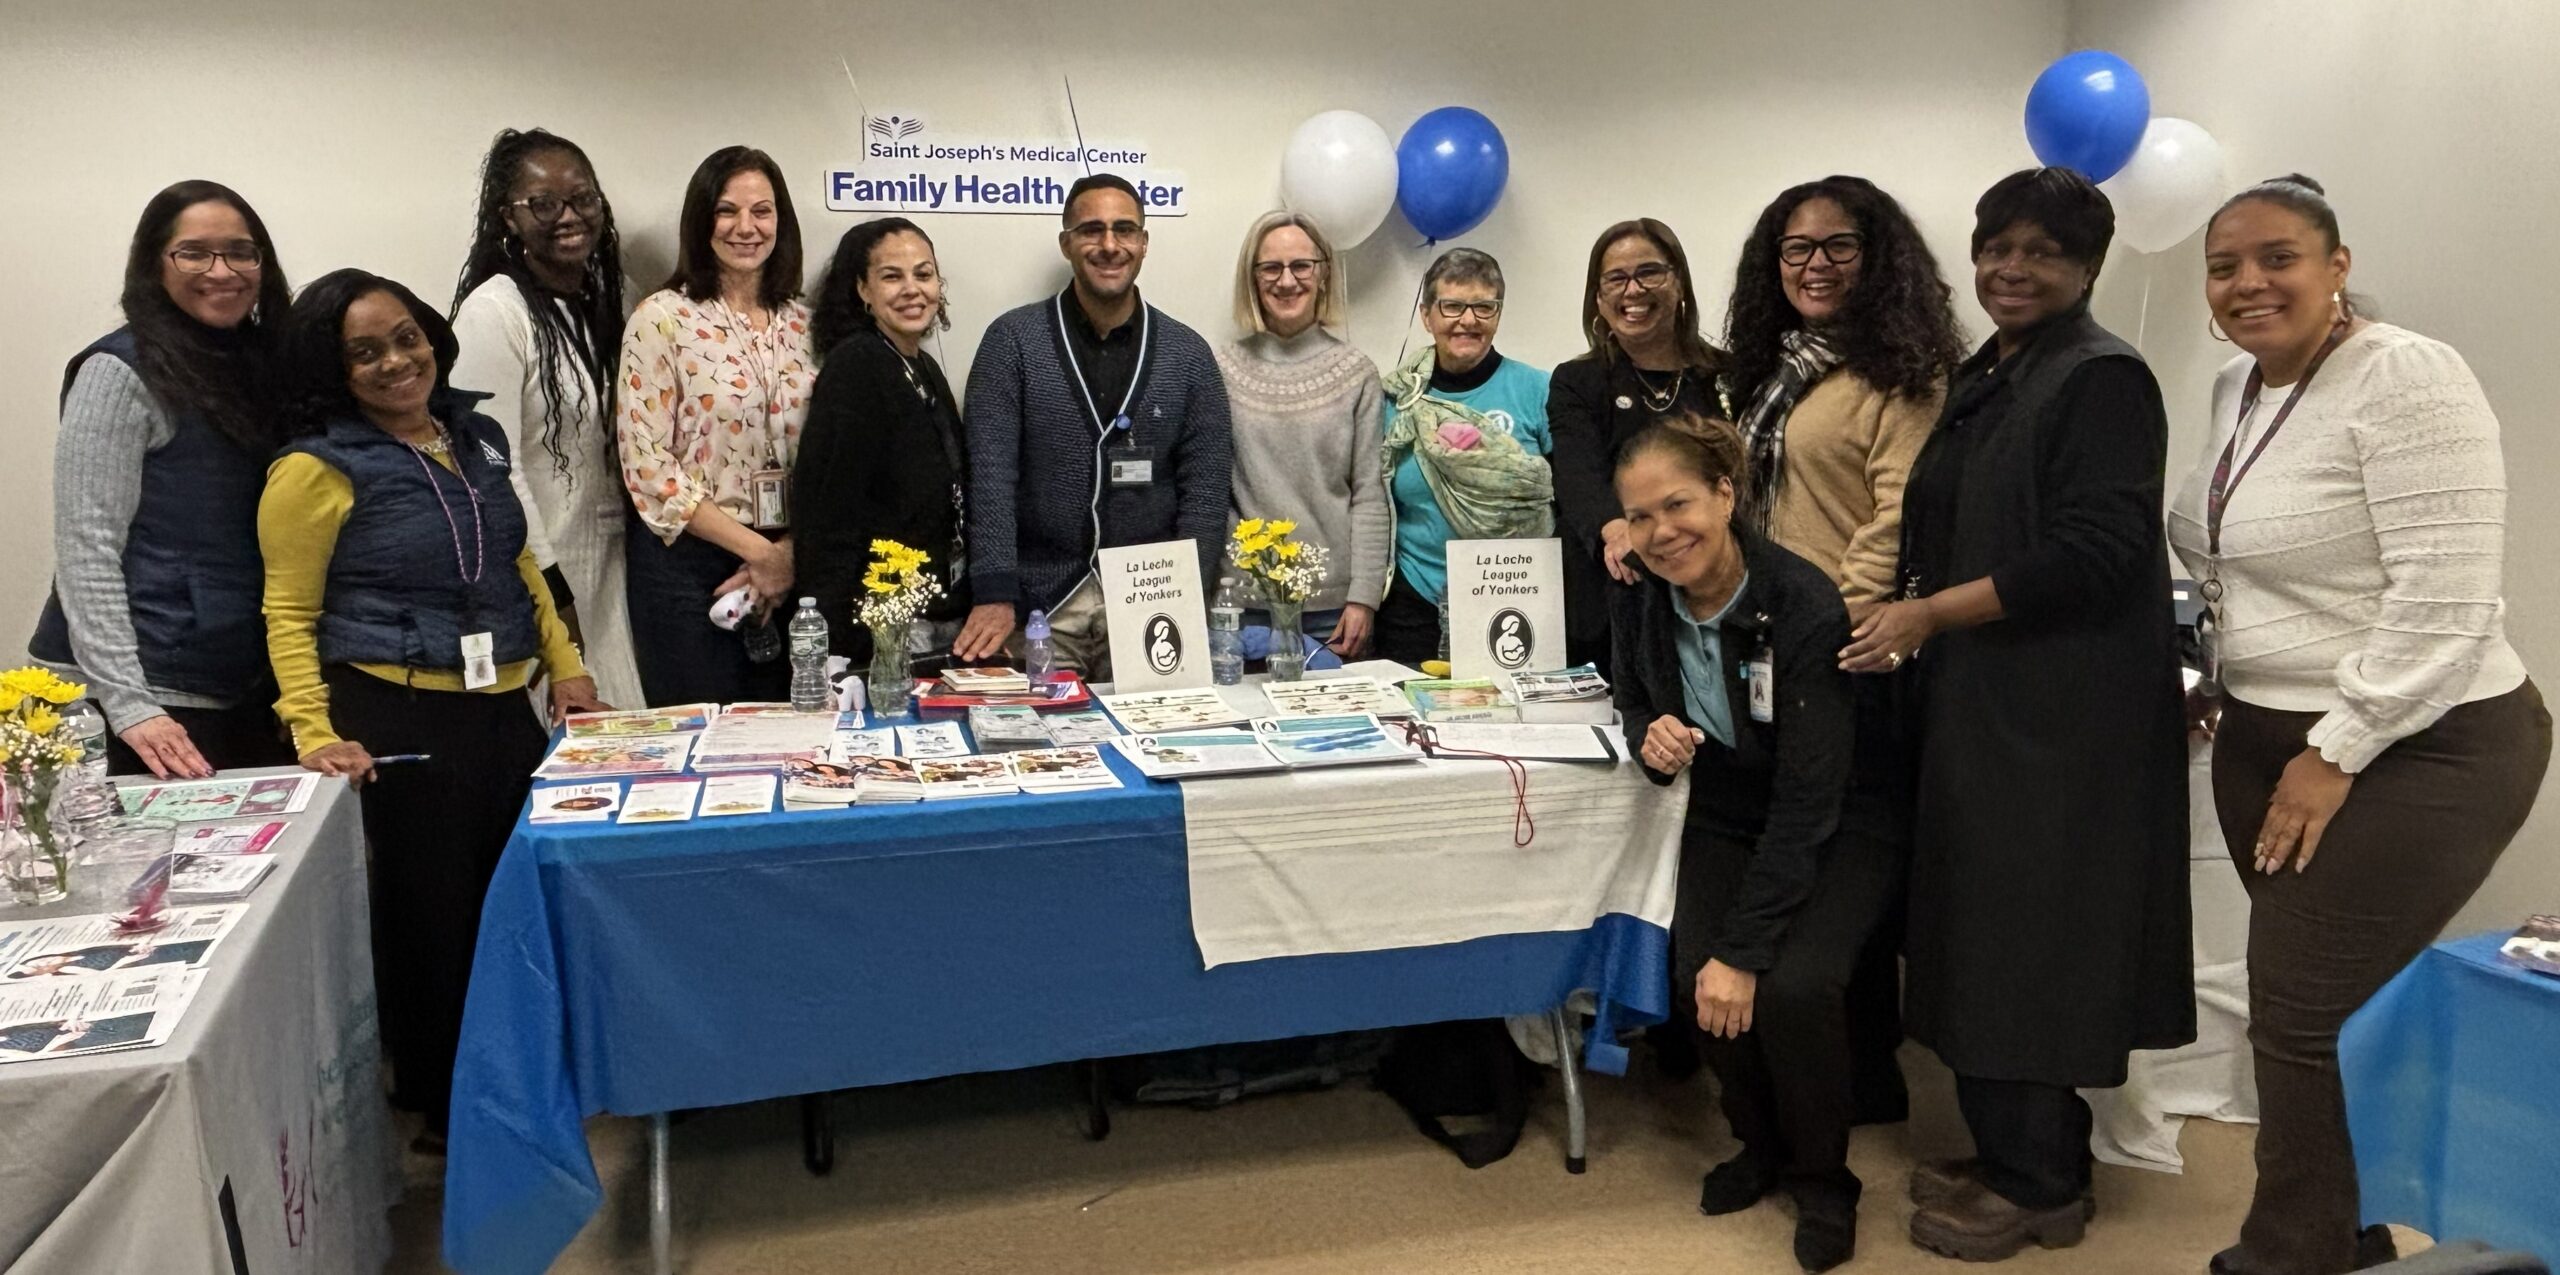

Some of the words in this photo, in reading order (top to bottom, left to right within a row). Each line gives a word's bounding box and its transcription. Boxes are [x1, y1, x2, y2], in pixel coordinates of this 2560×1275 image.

[870, 141, 920, 159] Saint
[924, 144, 1004, 163] Joseph's
[1010, 146, 1082, 162] Medical
[1086, 149, 1147, 164] Center
[833, 171, 948, 209] Family
[954, 174, 1064, 205] Health
[1138, 180, 1184, 207] ter
[1126, 562, 1139, 573] La
[1142, 558, 1174, 571] Leche
[1476, 554, 1491, 566] La
[1495, 554, 1533, 565] Leche
[1133, 575, 1172, 588] League
[1482, 569, 1528, 583] League
[1125, 592, 1137, 605] of
[1139, 589, 1182, 602] Yonkers
[1472, 584, 1486, 596] of
[1489, 584, 1539, 596] Yonkers
